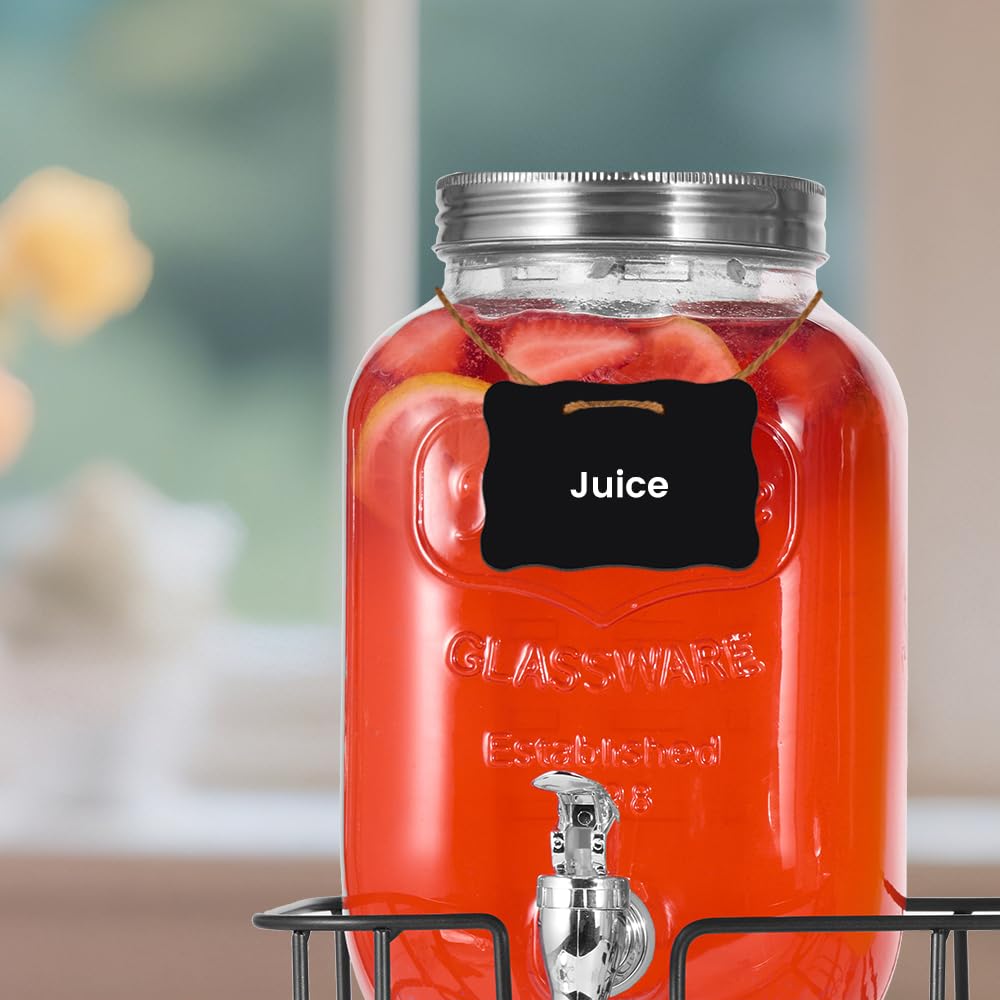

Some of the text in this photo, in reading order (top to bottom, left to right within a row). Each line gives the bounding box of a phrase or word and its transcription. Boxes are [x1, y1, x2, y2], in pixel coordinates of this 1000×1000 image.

[570, 468, 669, 499] Juice
[446, 631, 766, 691] GLASSWARE
[482, 732, 721, 767] Established
